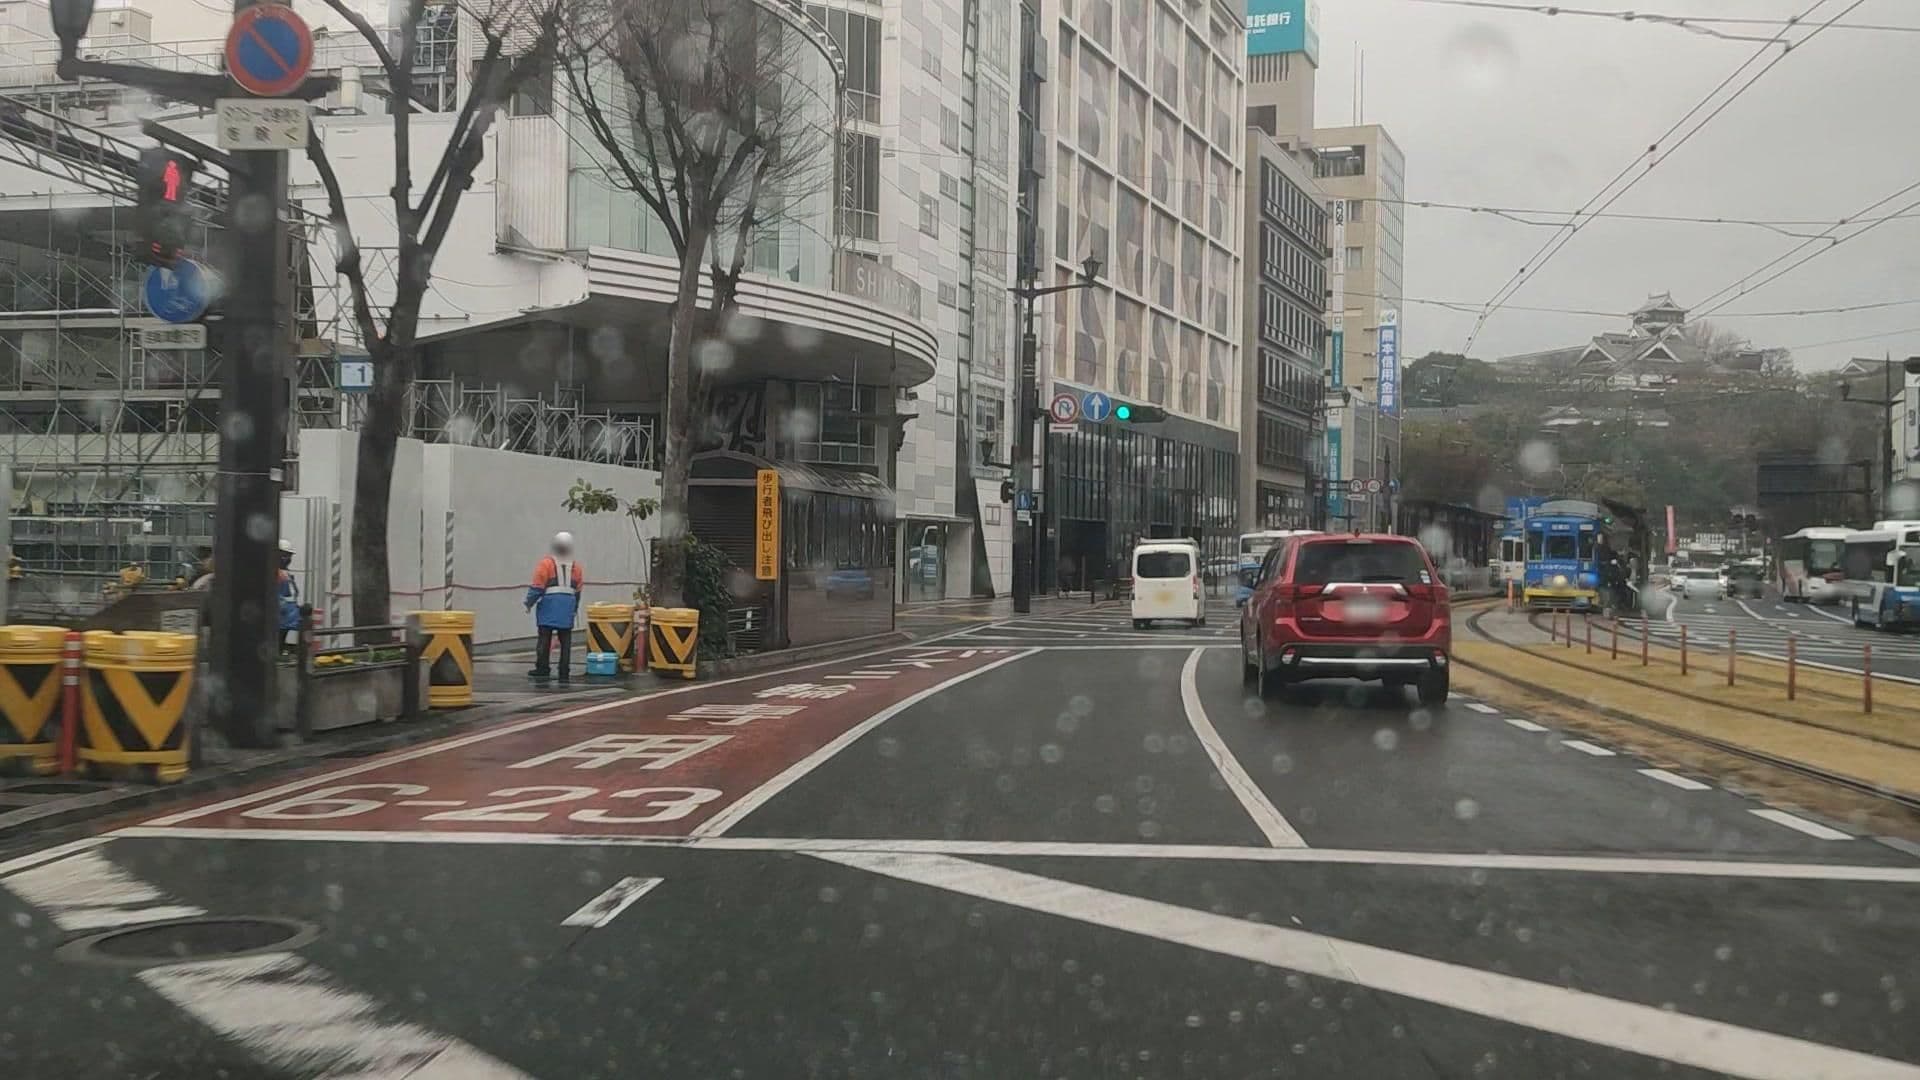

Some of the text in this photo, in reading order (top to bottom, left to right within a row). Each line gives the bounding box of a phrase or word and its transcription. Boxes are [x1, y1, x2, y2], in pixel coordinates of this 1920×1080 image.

[1381, 329, 1394, 407] 熊本信用金庫
[761, 473, 773, 577] 歩行者飛び出し注意
[240, 783, 723, 825] 6-23
